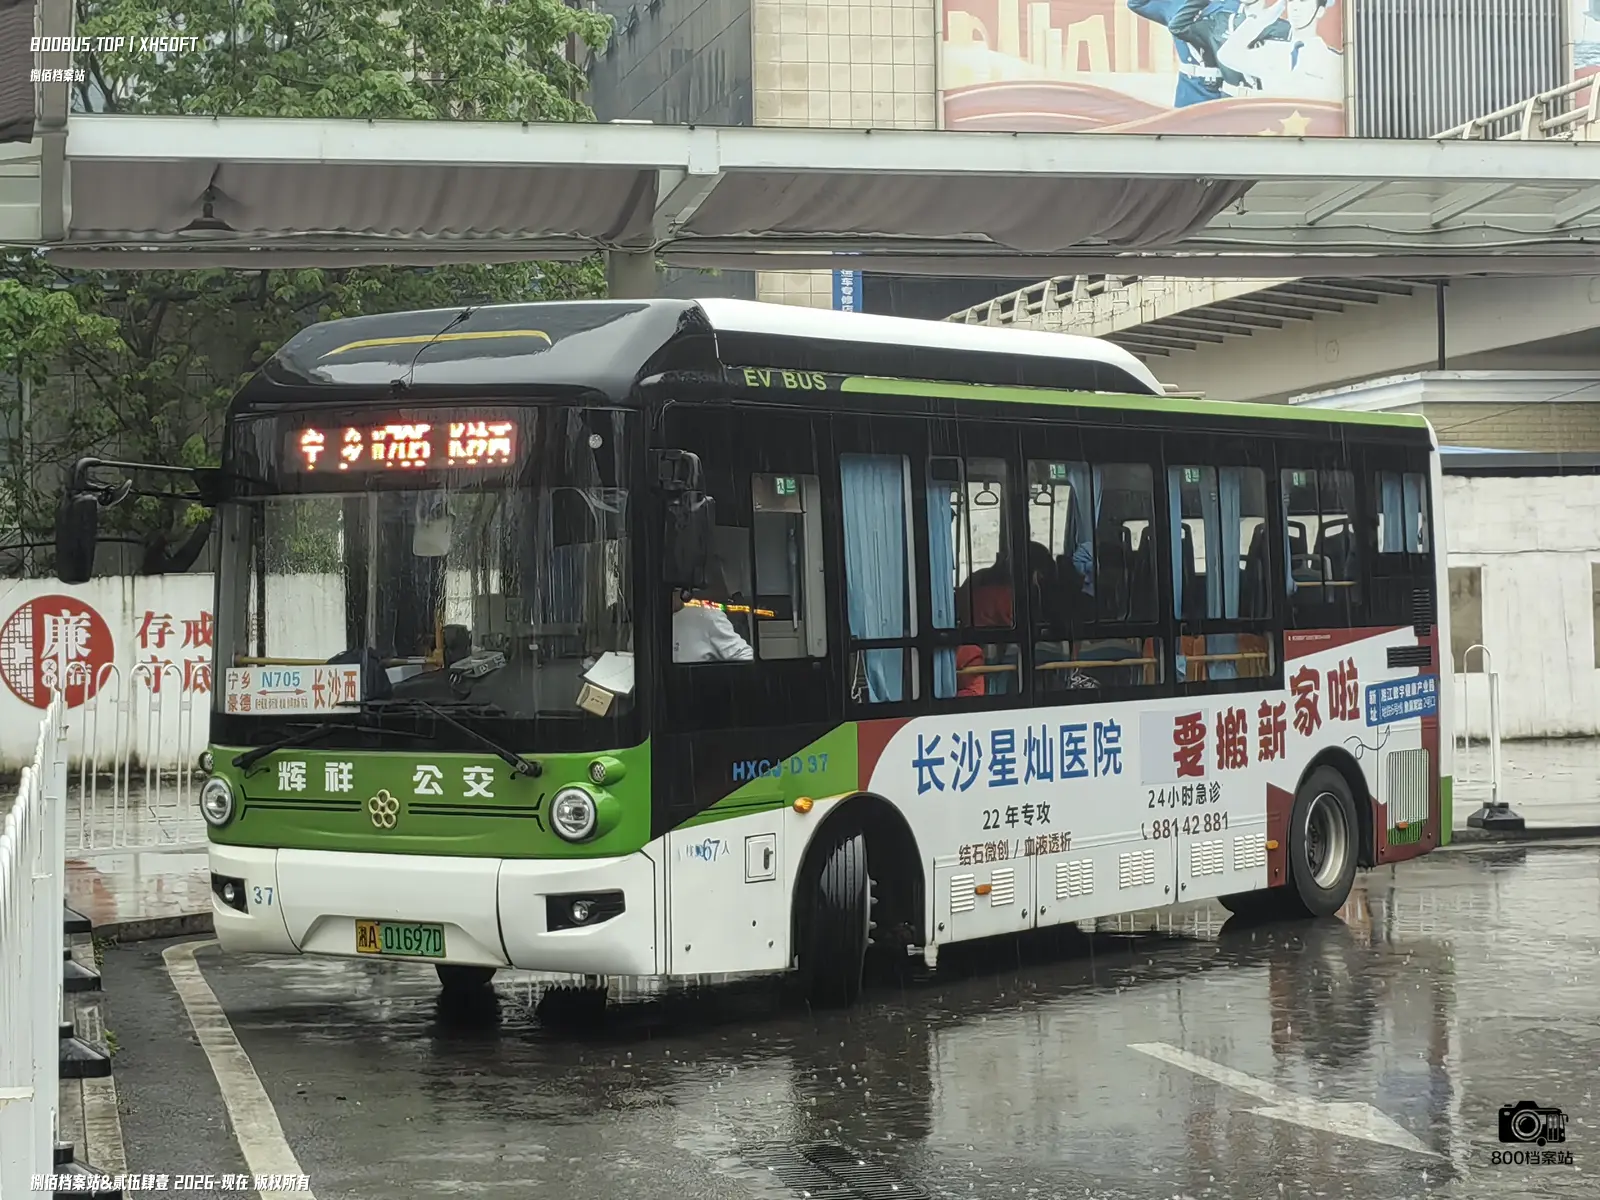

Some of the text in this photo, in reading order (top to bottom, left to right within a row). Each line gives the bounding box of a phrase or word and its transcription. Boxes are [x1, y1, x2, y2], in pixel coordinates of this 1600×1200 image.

[743, 369, 828, 391] EV BUS
[228, 671, 251, 690] 宁乡
[261, 671, 301, 688] N705
[312, 667, 357, 711] 长沙西
[1173, 656, 1361, 779] 要搬新家啦
[912, 717, 1124, 796] 长沙星灿医院
[277, 760, 495, 798] 辉祥 公交
[1148, 780, 1221, 809] 24小时急诊
[253, 886, 274, 906] 37
